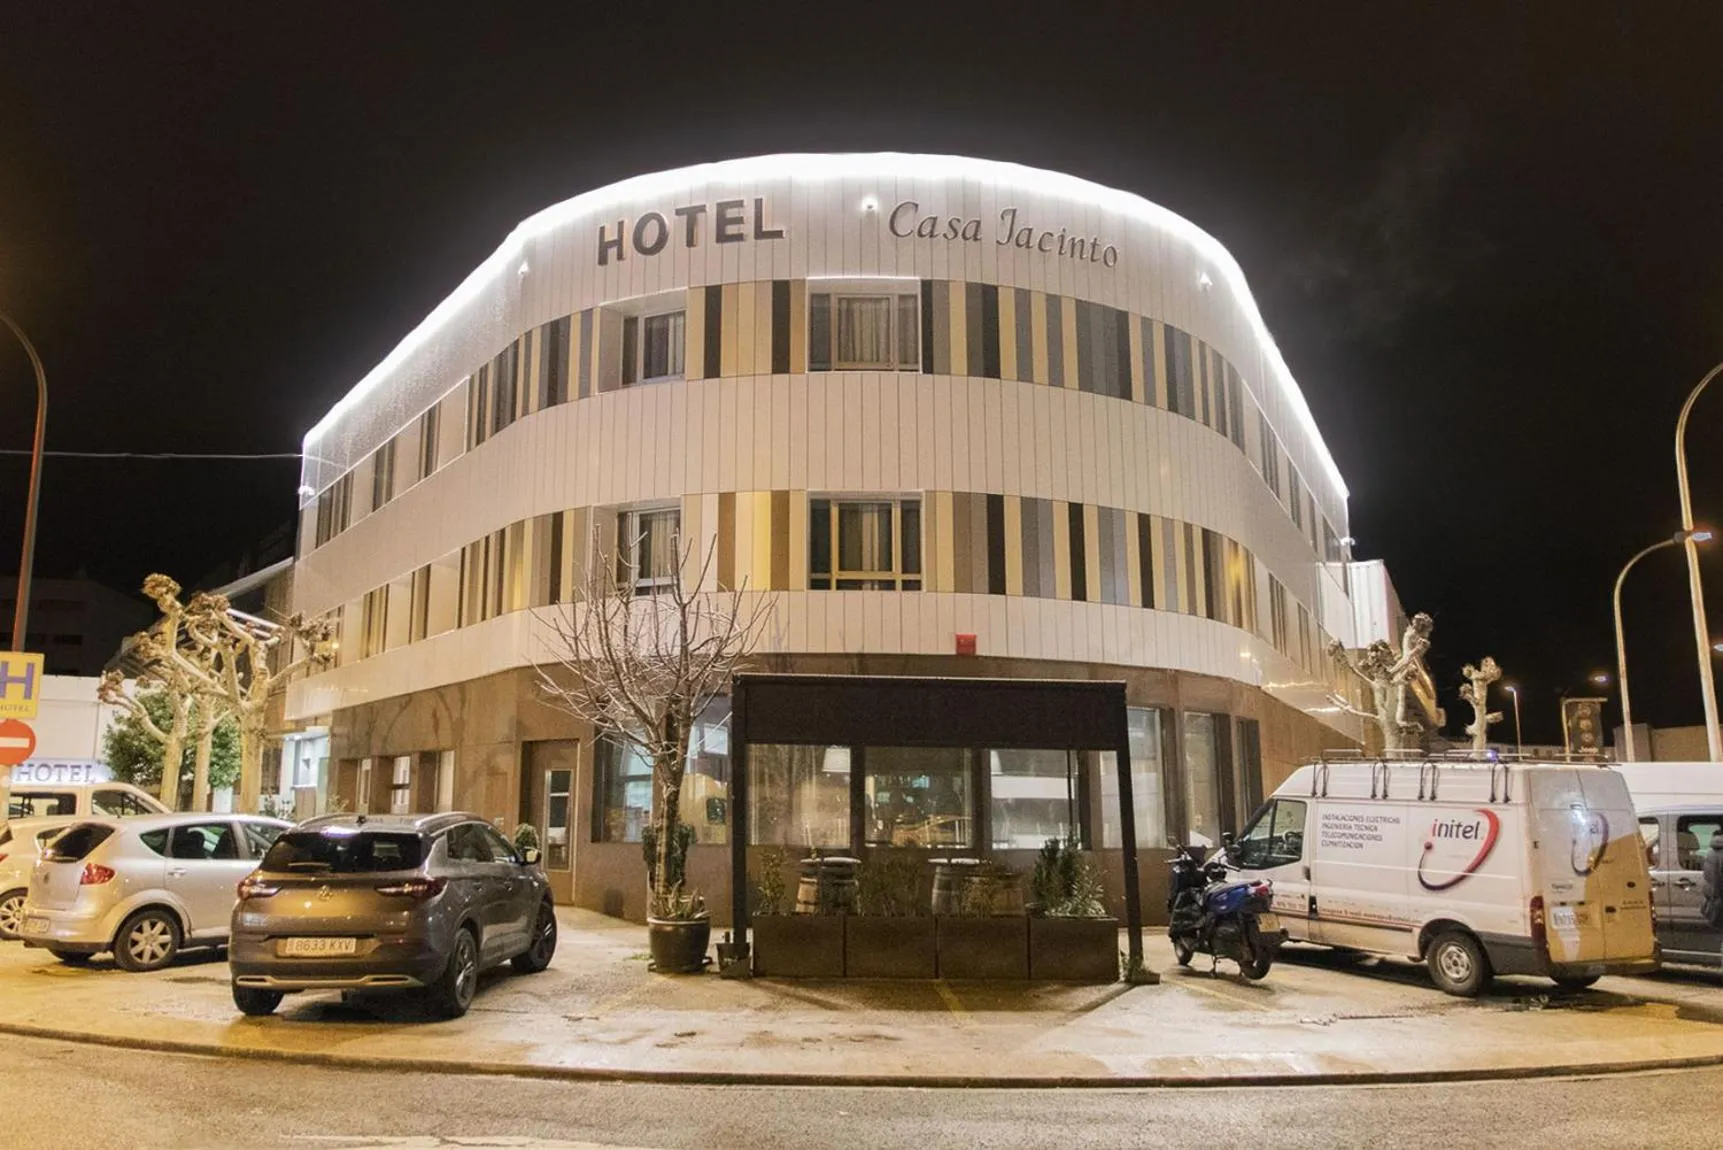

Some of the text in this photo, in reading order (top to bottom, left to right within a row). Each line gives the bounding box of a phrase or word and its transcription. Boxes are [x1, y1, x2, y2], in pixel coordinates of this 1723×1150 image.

[598, 198, 785, 266] HOTEL
[889, 201, 1118, 268] Casa Jacinto
[0, 661, 34, 699] H
[15, 763, 95, 783] HOTEL
[1431, 818, 1481, 840] initel
